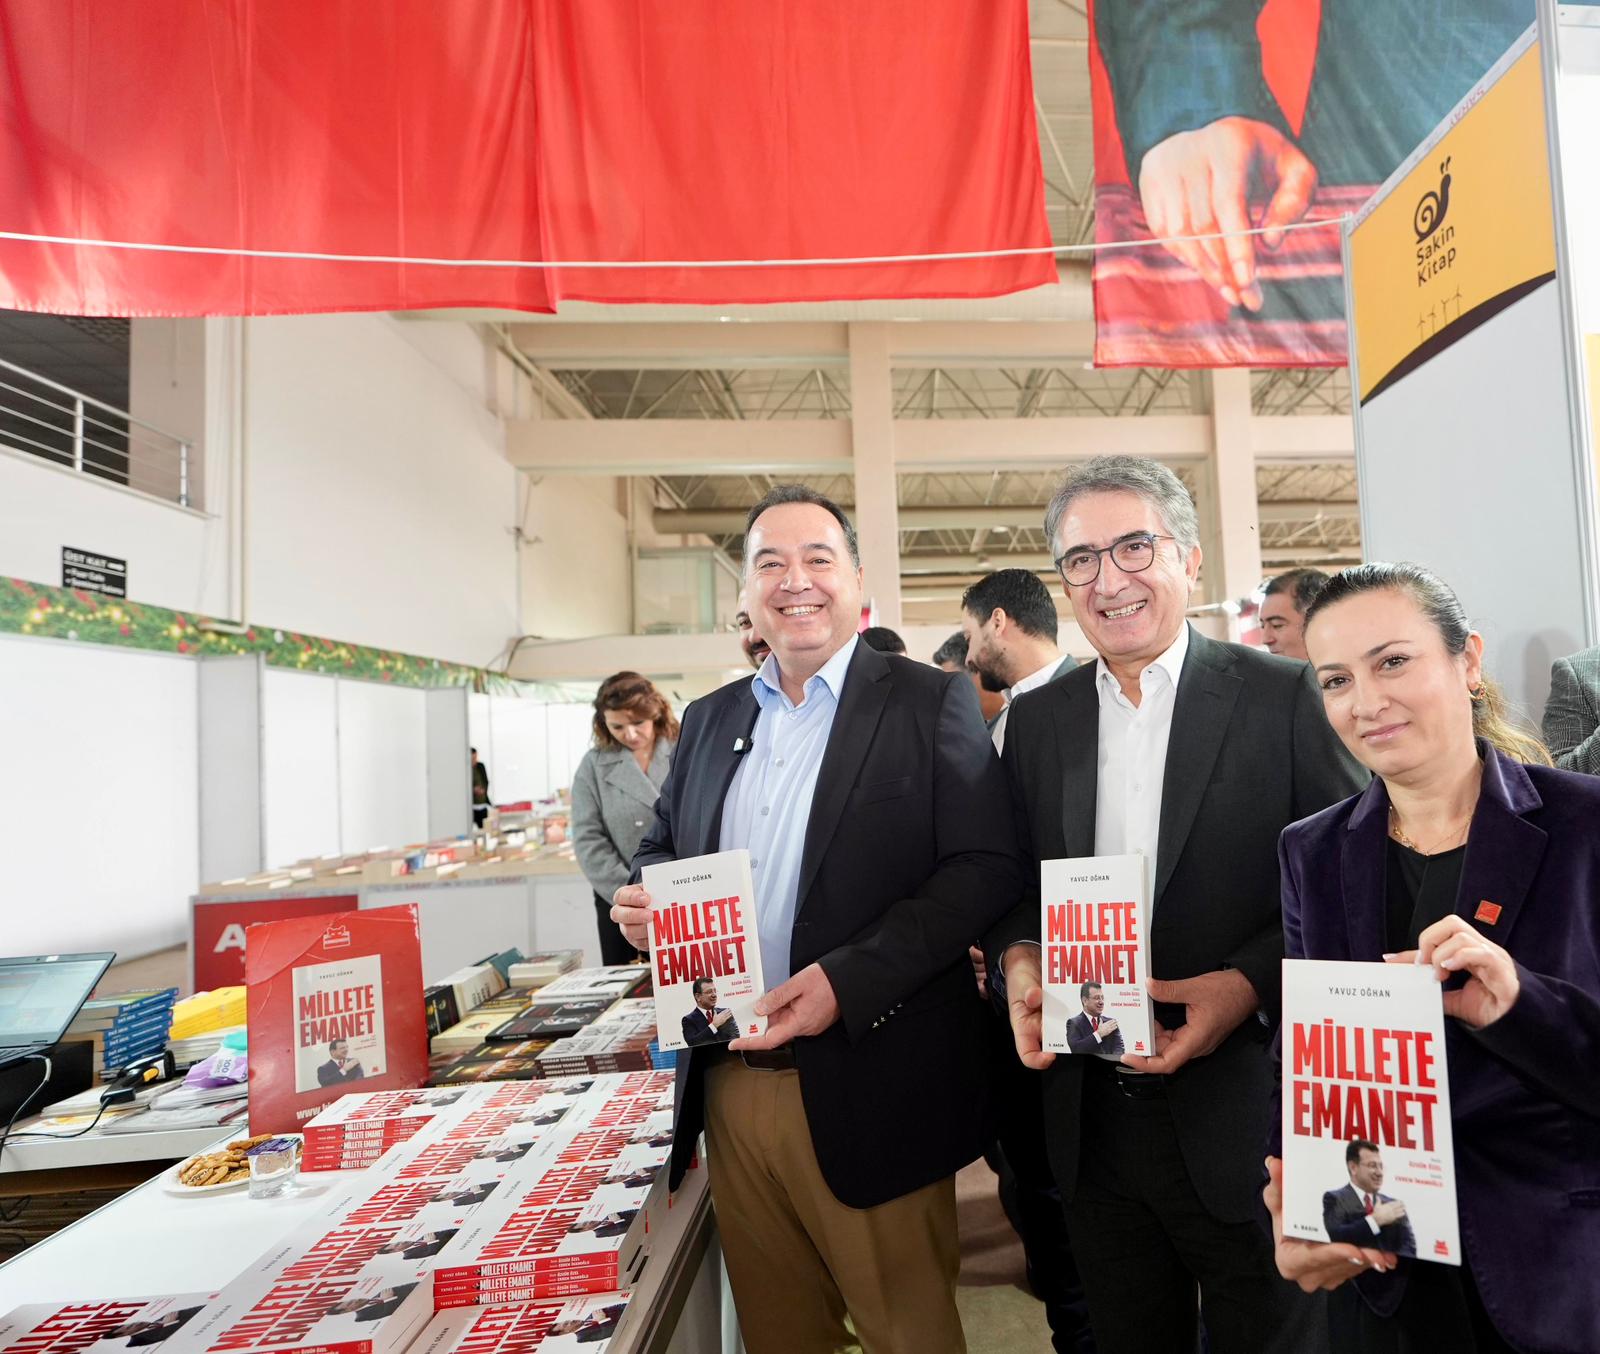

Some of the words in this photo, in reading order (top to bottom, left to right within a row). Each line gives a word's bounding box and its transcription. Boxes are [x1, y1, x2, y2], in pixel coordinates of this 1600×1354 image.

[1416, 226, 1454, 266] Sakin
[1417, 247, 1456, 287] Kitap
[672, 877, 691, 886] YAVUZ
[692, 874, 712, 883] OĞHAN
[1090, 874, 1110, 882] OĞHAN
[653, 896, 744, 947] MİLLETE
[1047, 899, 1137, 942] MİLLETE
[656, 936, 746, 987] EMANET
[1047, 944, 1138, 984] EMANET
[299, 984, 375, 1021] MİLLETE
[1328, 987, 1357, 996] YAVUZ
[1360, 987, 1391, 998] OĞHAN
[300, 1010, 375, 1048] EMANET
[1293, 1018, 1436, 1088] MİLLETE
[345, 1121, 366, 1132] MİLLETE
[366, 1120, 385, 1130] EMANET
[588, 1099, 634, 1128] MİLLETE
[1293, 1080, 1438, 1152] EMANET
[342, 1149, 363, 1160] MİLLETE
[363, 1148, 382, 1158] EMANET
[343, 1140, 364, 1150] MİLLETE
[364, 1138, 383, 1148] EMANET
[345, 1131, 365, 1141] MİLLETE
[365, 1129, 384, 1139] EMANET
[554, 1130, 607, 1164] MİLLETE
[588, 1128, 637, 1160] EMANET
[340, 1158, 360, 1169] MİLLETE
[394, 1142, 459, 1179] MİLLETE
[429, 1140, 491, 1176] EMANET
[378, 1180, 451, 1222] EMANET
[518, 1166, 579, 1208] MİLLETE
[556, 1164, 613, 1204] EMANET
[338, 1182, 417, 1226] MİLLETE
[475, 1209, 547, 1261] MİLLETE
[517, 1207, 585, 1256] EMANET
[273, 1228, 366, 1282] MİLLETE
[316, 1227, 404, 1279] EMANET
[480, 1263, 508, 1277] MİLLETE
[509, 1261, 537, 1274] EMANET
[479, 1277, 507, 1291] MİLLETE
[508, 1274, 535, 1288] EMANET
[479, 1291, 507, 1304] MİLLETE
[508, 1288, 535, 1301] EMANET
[205, 1282, 316, 1352] MİLLETE
[256, 1281, 359, 1346] EMANET
